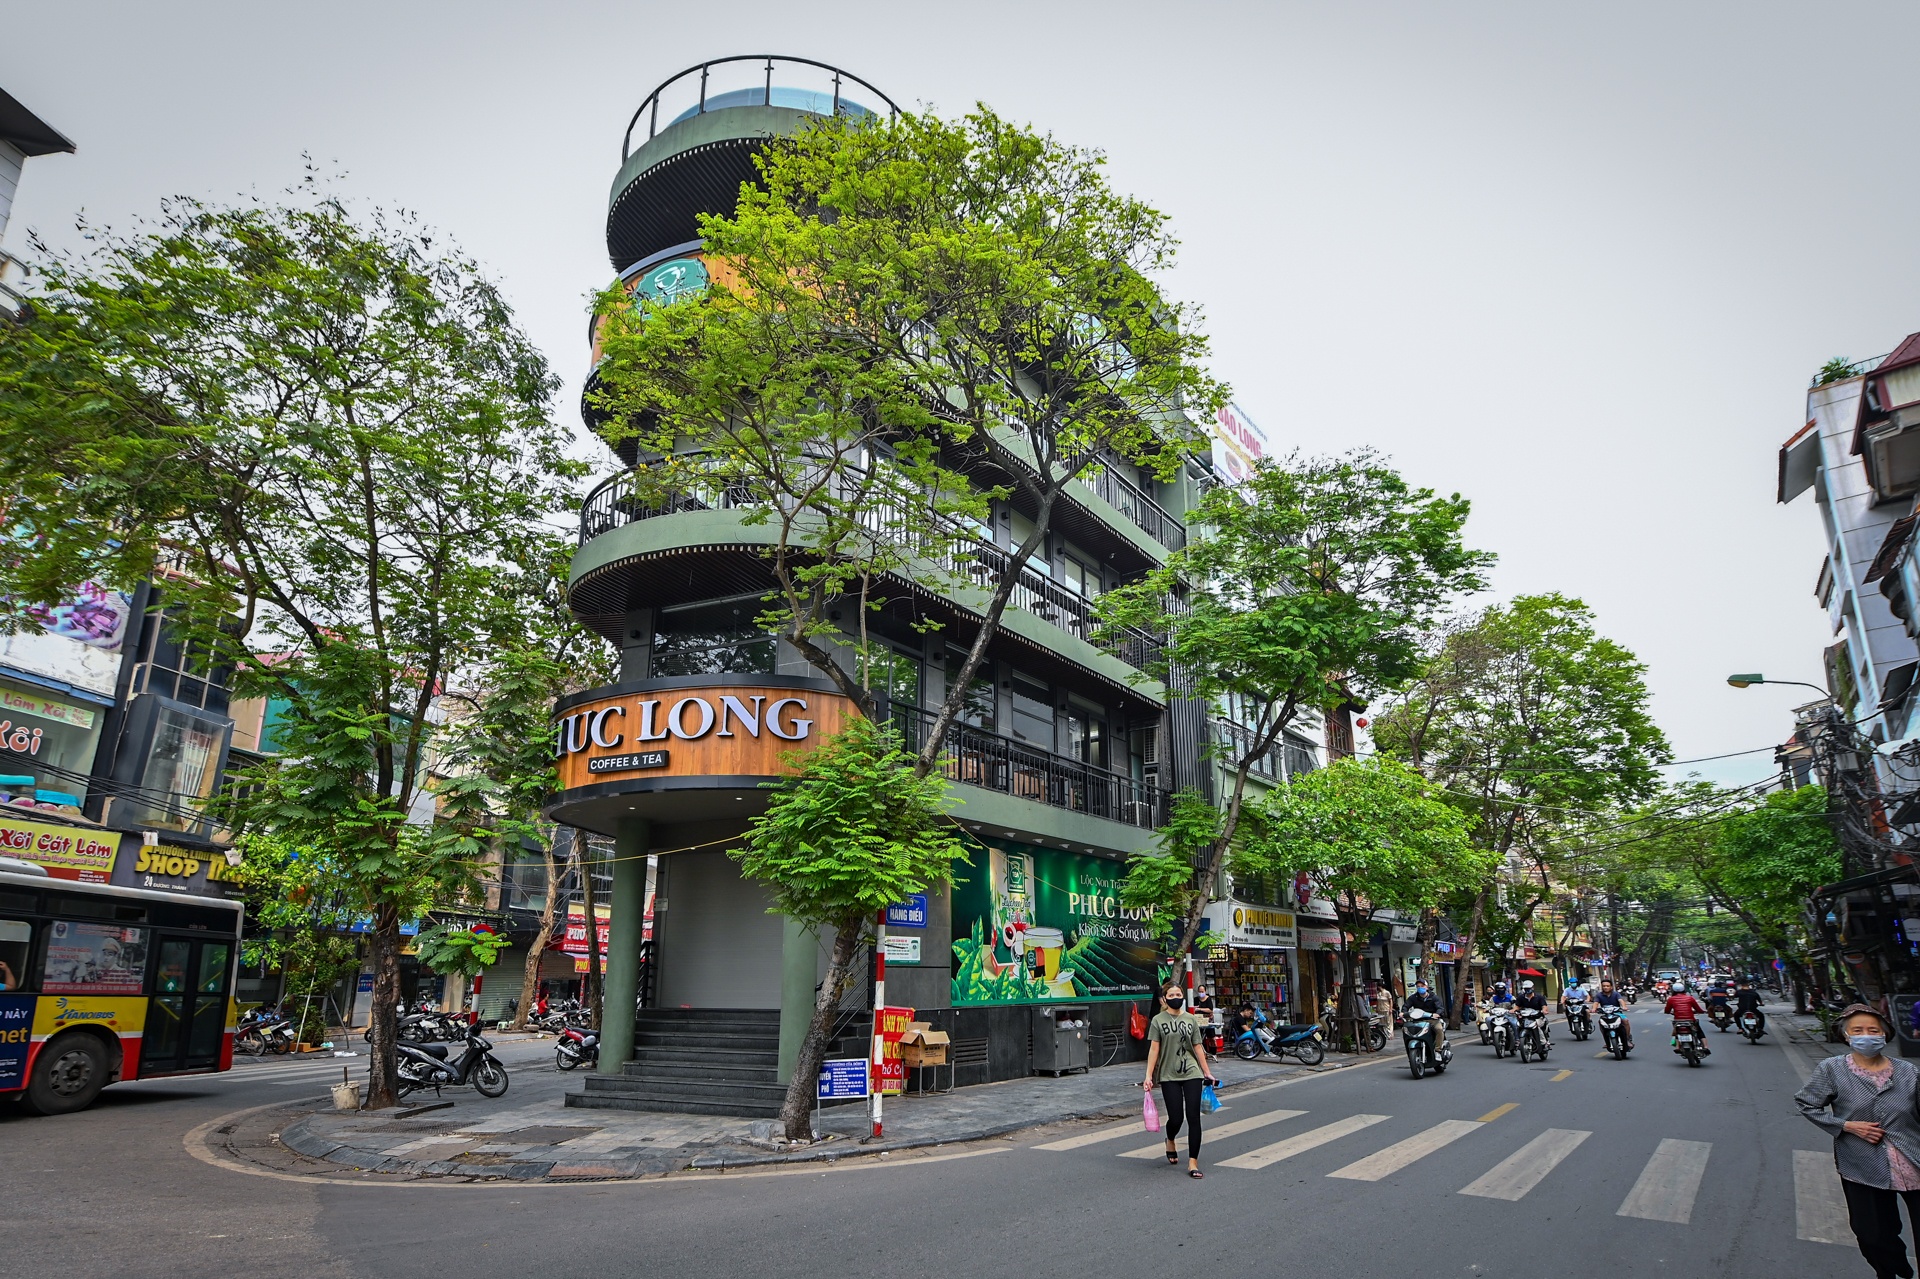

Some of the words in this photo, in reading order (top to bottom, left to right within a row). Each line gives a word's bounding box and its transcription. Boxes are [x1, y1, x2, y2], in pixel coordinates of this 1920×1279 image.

[1238, 421, 1262, 460] LONG
[4, 692, 36, 712] Lâm
[42, 703, 67, 720] Xôi
[550, 708, 626, 760] HUC
[636, 695, 814, 742] LONG
[590, 757, 630, 771] COFFEE
[632, 756, 640, 767] &
[642, 753, 663, 768] TEA
[0, 828, 34, 850] Xôi
[37, 834, 72, 854] Cát
[75, 837, 111, 858] Lâm
[134, 845, 199, 877] SHOP
[144, 875, 153, 887] 24
[1080, 874, 1094, 887] Lộc
[1095, 877, 1109, 888] Non
[1069, 889, 1117, 919] PHÚC
[890, 906, 908, 921] HÀNG
[908, 907, 923, 923] ĐIẾU
[1101, 924, 1117, 938] Sức
[1118, 923, 1139, 943] Sống
[4, 1008, 28, 1019] NÀY
[883, 1010, 896, 1033] ÁNH
[1161, 1020, 1193, 1036] BUGS
[882, 1063, 891, 1076] hố
